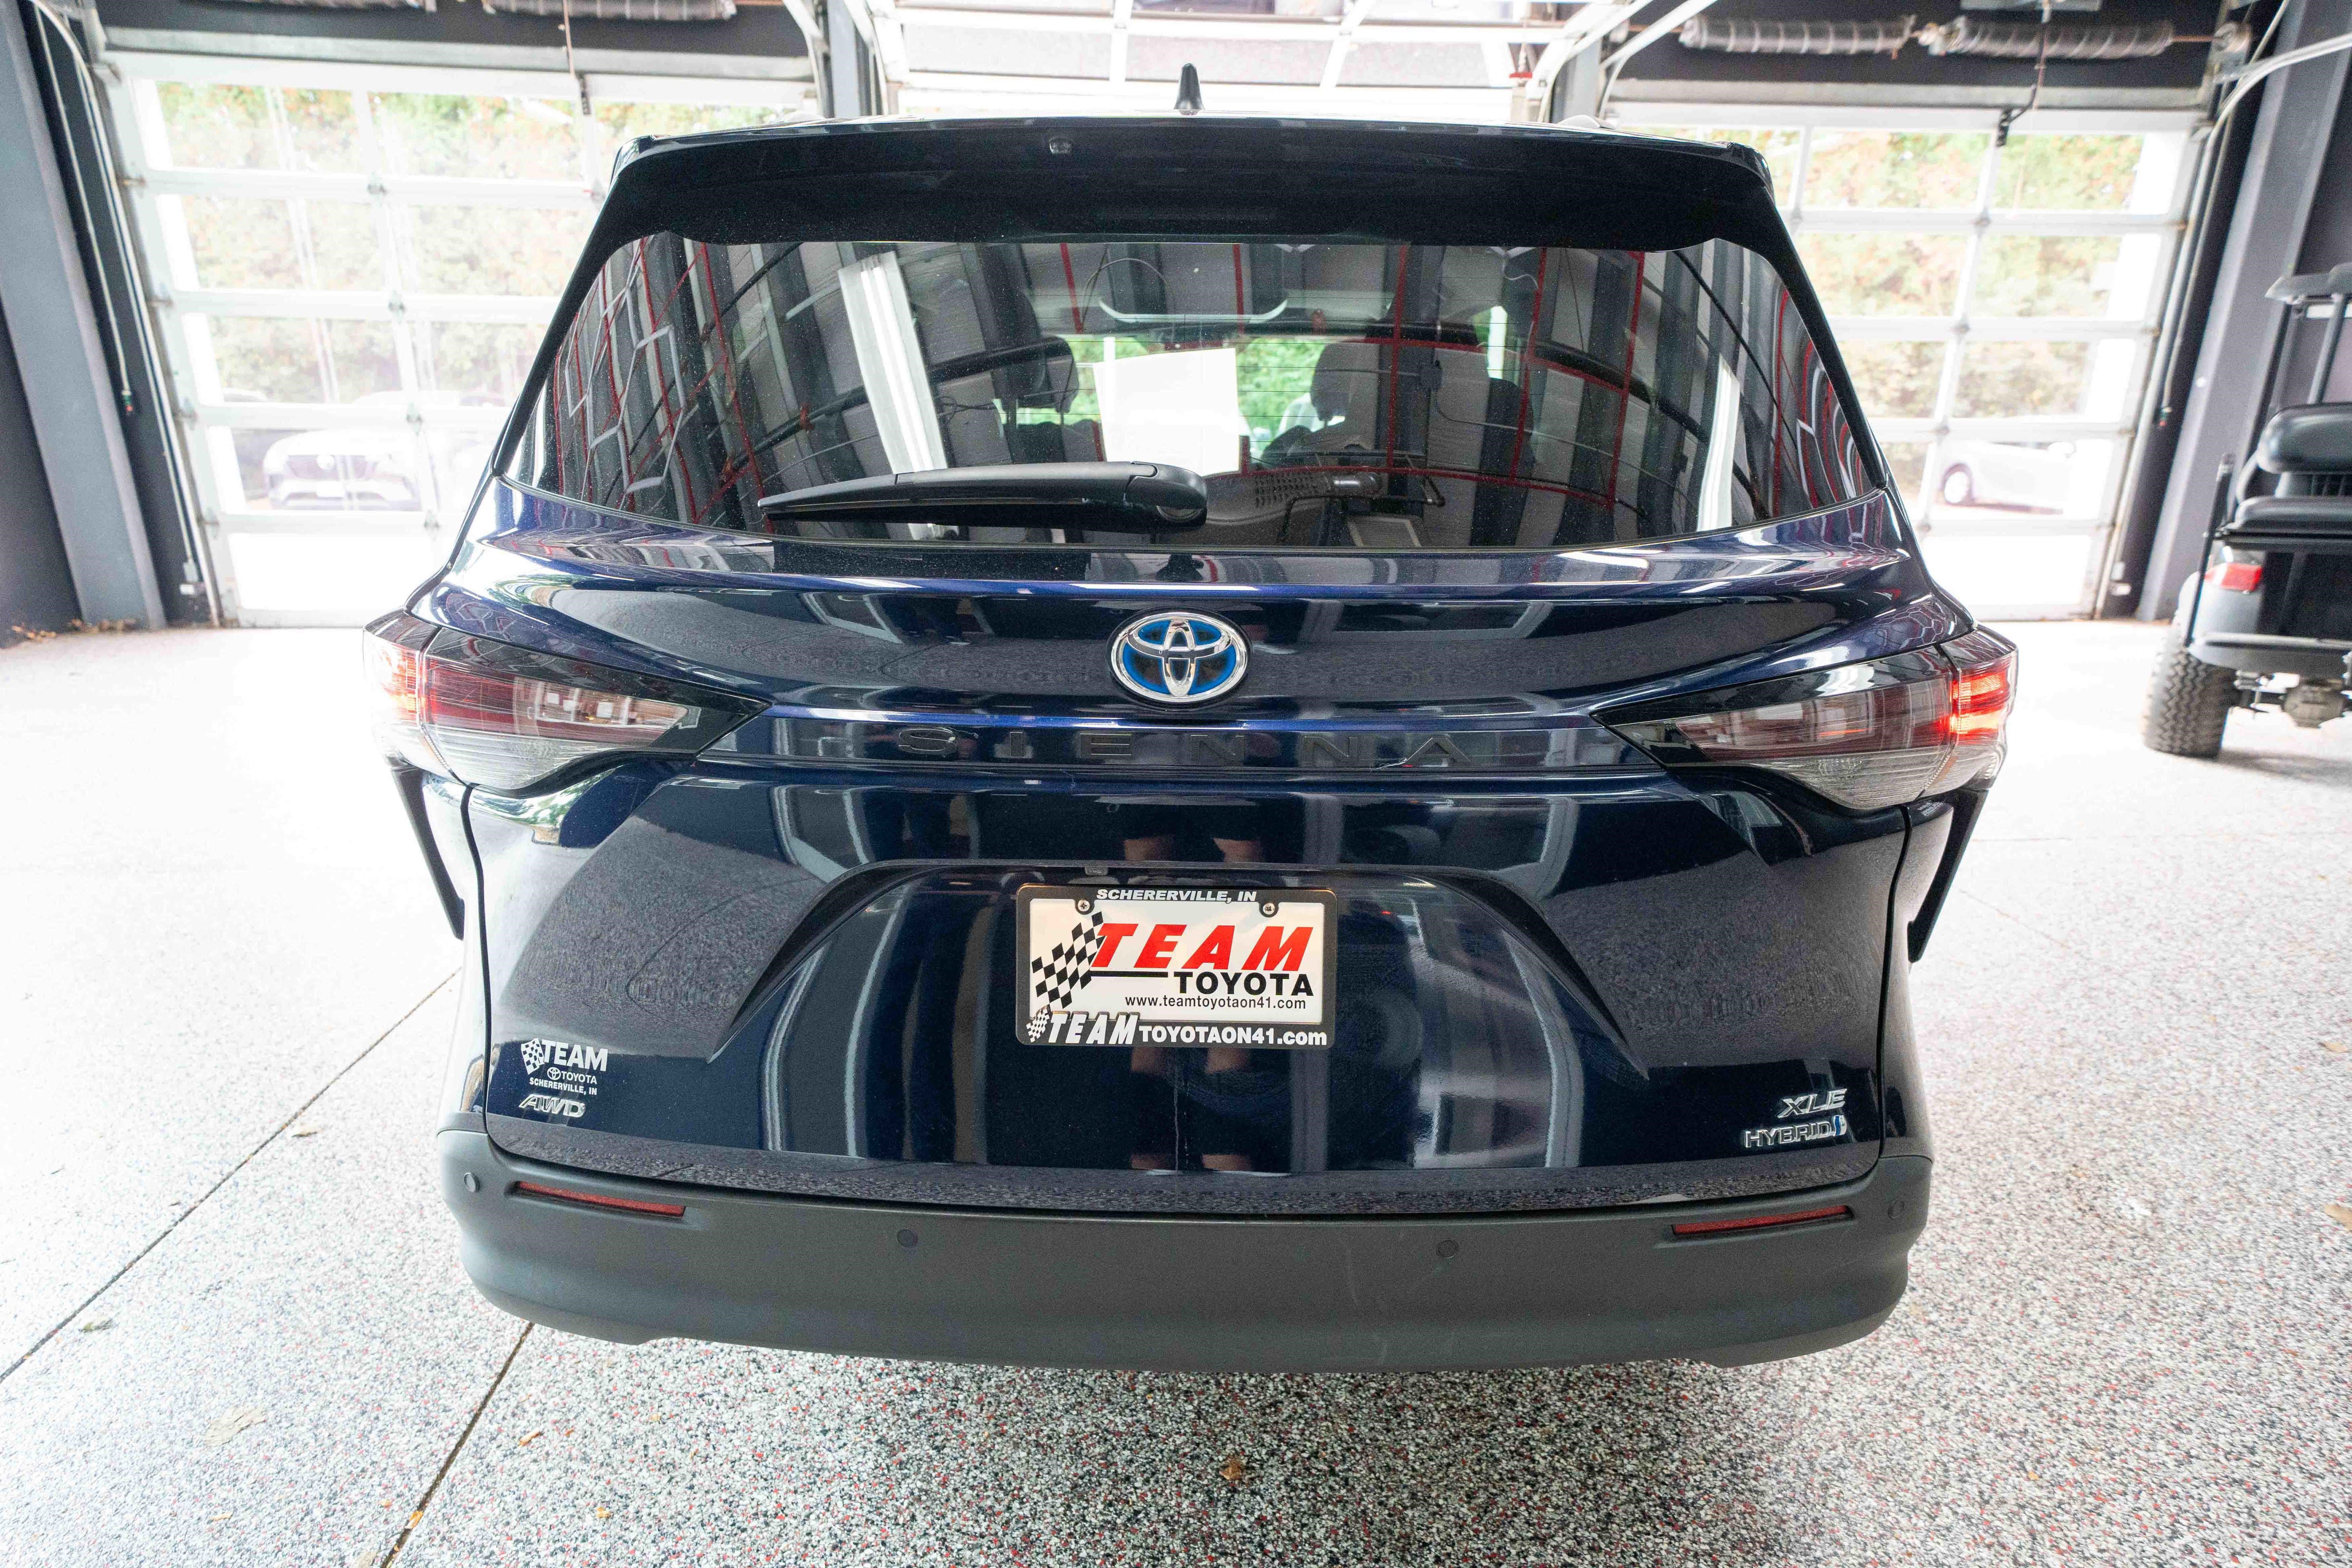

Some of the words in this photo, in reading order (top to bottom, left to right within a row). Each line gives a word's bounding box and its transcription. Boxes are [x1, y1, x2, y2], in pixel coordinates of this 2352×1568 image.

[898, 728, 1471, 764] SIENNA
[1096, 889, 1232, 903] SCHERERVILLE,
[1237, 891, 1257, 902] IN
[1090, 923, 1314, 971] TEAM
[1174, 971, 1314, 996] TOYOTA
[1125, 995, 1306, 1010] www.teamtoyotaon41.com
[541, 1039, 608, 1071] TEAM
[529, 1077, 586, 1095] SCHERERVILLE,
[588, 1087, 597, 1095] IN
[561, 1071, 597, 1085] TOYOTA
[518, 1094, 586, 1118] AWD
[1777, 1088, 1847, 1118] XLE
[1744, 1121, 1834, 1148] HYBRID
